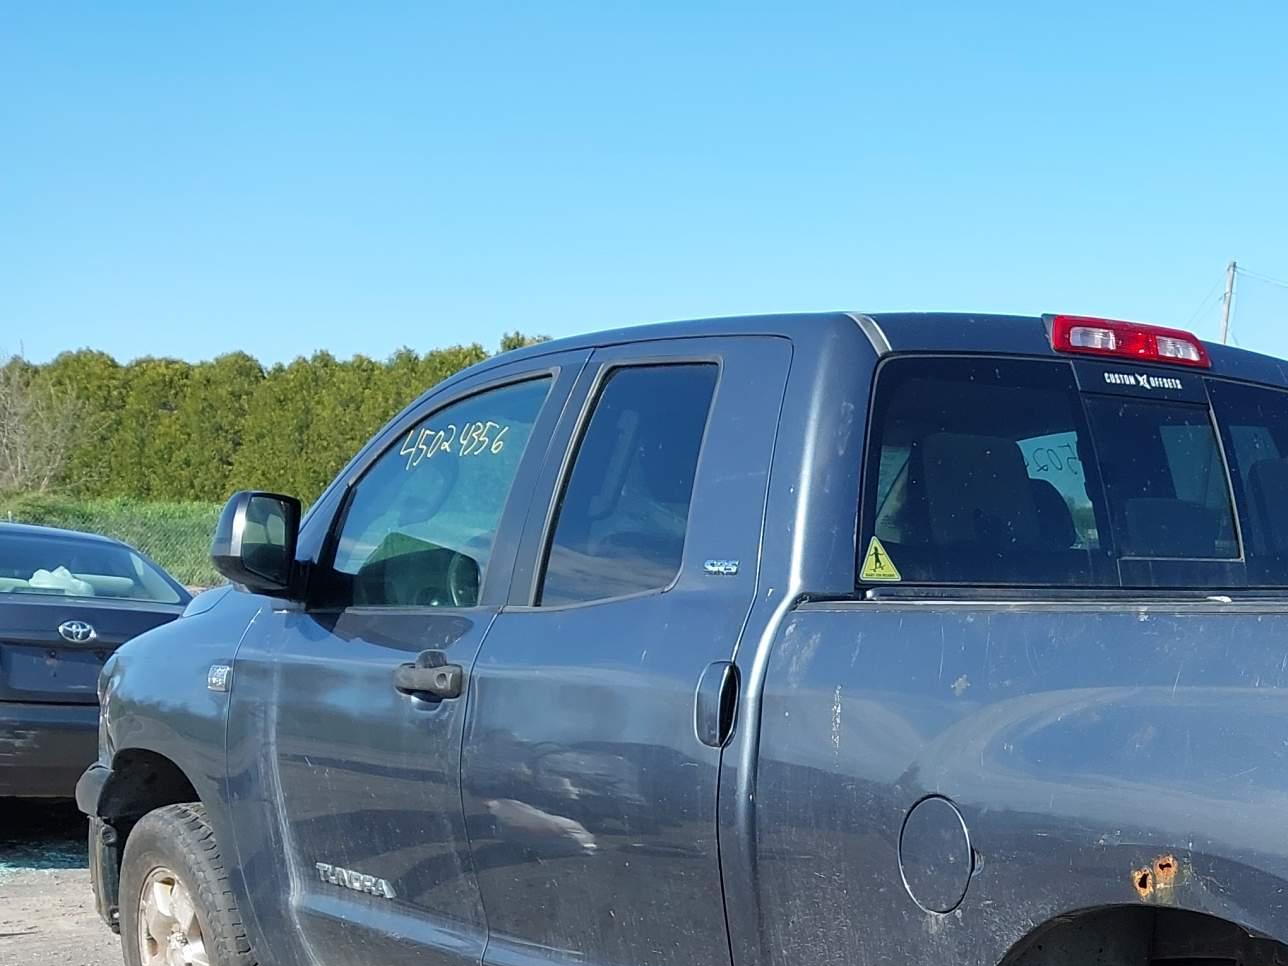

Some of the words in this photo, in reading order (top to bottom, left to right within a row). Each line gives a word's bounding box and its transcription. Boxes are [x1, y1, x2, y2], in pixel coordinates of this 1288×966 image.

[1103, 372, 1136, 385] CUSTOM
[1149, 376, 1183, 390] OFFSETS
[400, 419, 510, 471] 45024356
[315, 861, 397, 899] TUNDRA
